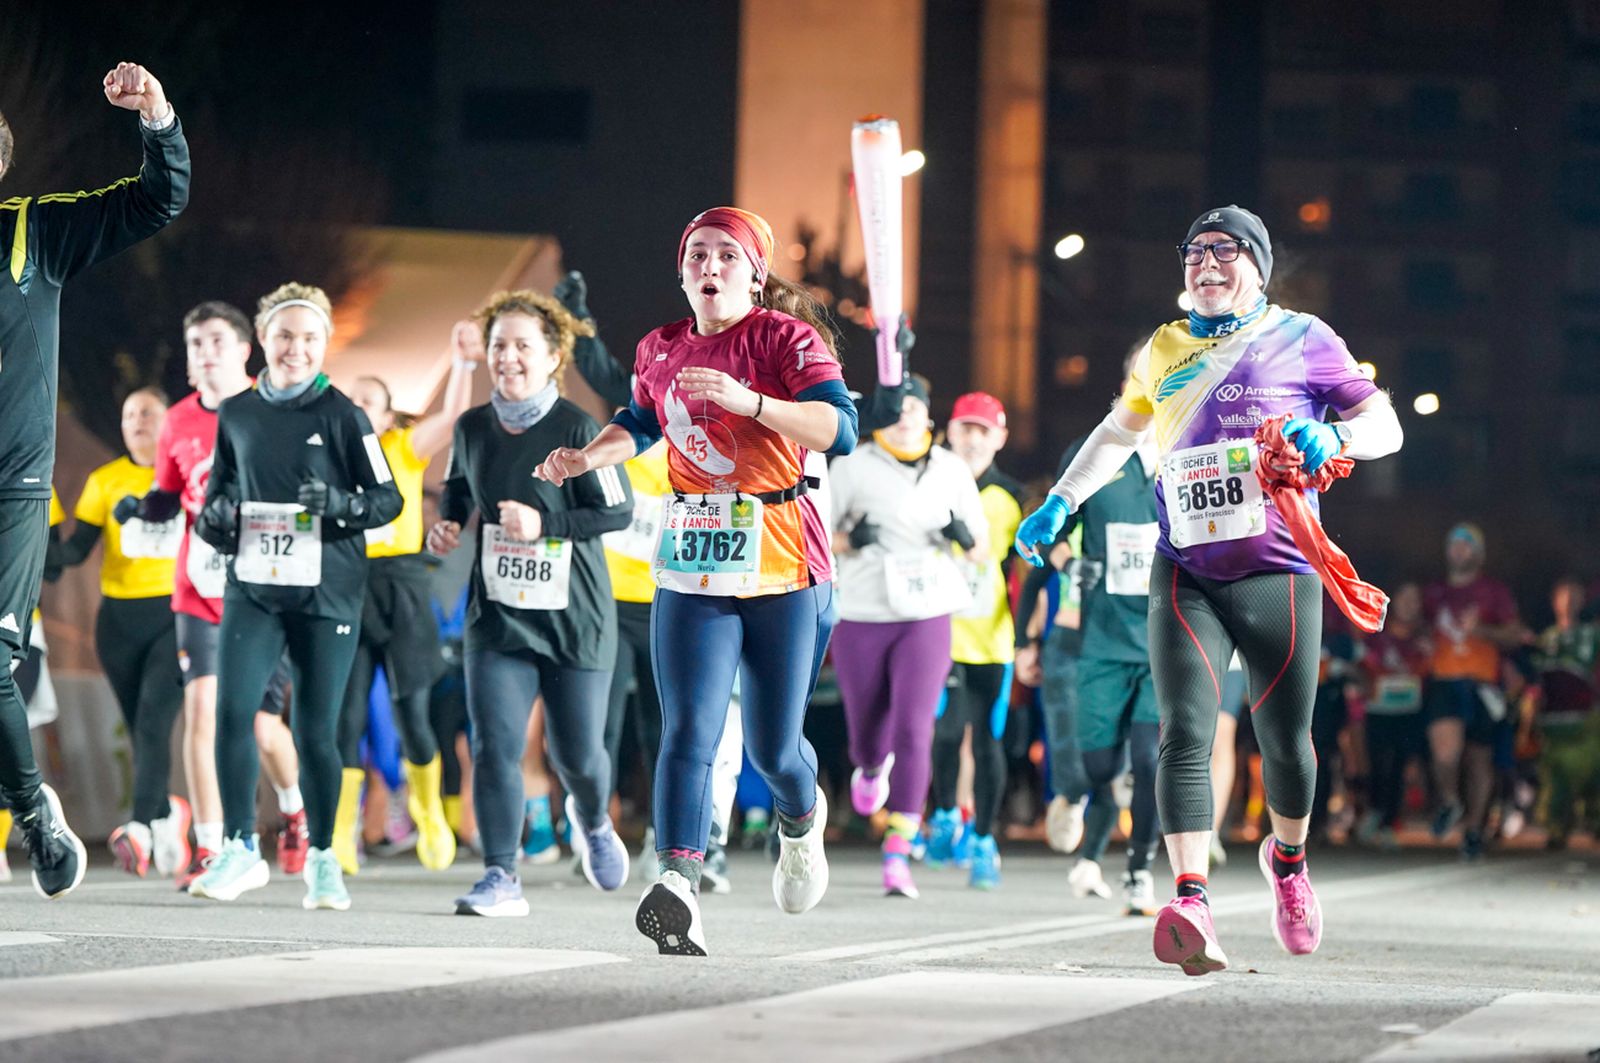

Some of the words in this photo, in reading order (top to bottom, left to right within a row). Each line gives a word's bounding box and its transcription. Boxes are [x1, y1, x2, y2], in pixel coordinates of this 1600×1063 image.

[686, 434, 708, 462] 43
[1181, 457, 1204, 470] OCHE
[1206, 454, 1218, 466] DE
[1187, 465, 1220, 482] ANTÓN
[1177, 476, 1244, 513] 5858
[683, 505, 706, 517] OCHE
[708, 505, 721, 516] DE
[1205, 508, 1235, 519] Francisco
[670, 517, 686, 529] SN
[687, 516, 721, 529] ANTÓN
[261, 532, 294, 556] 512
[672, 530, 747, 562] 13762
[497, 555, 552, 582] 6588
